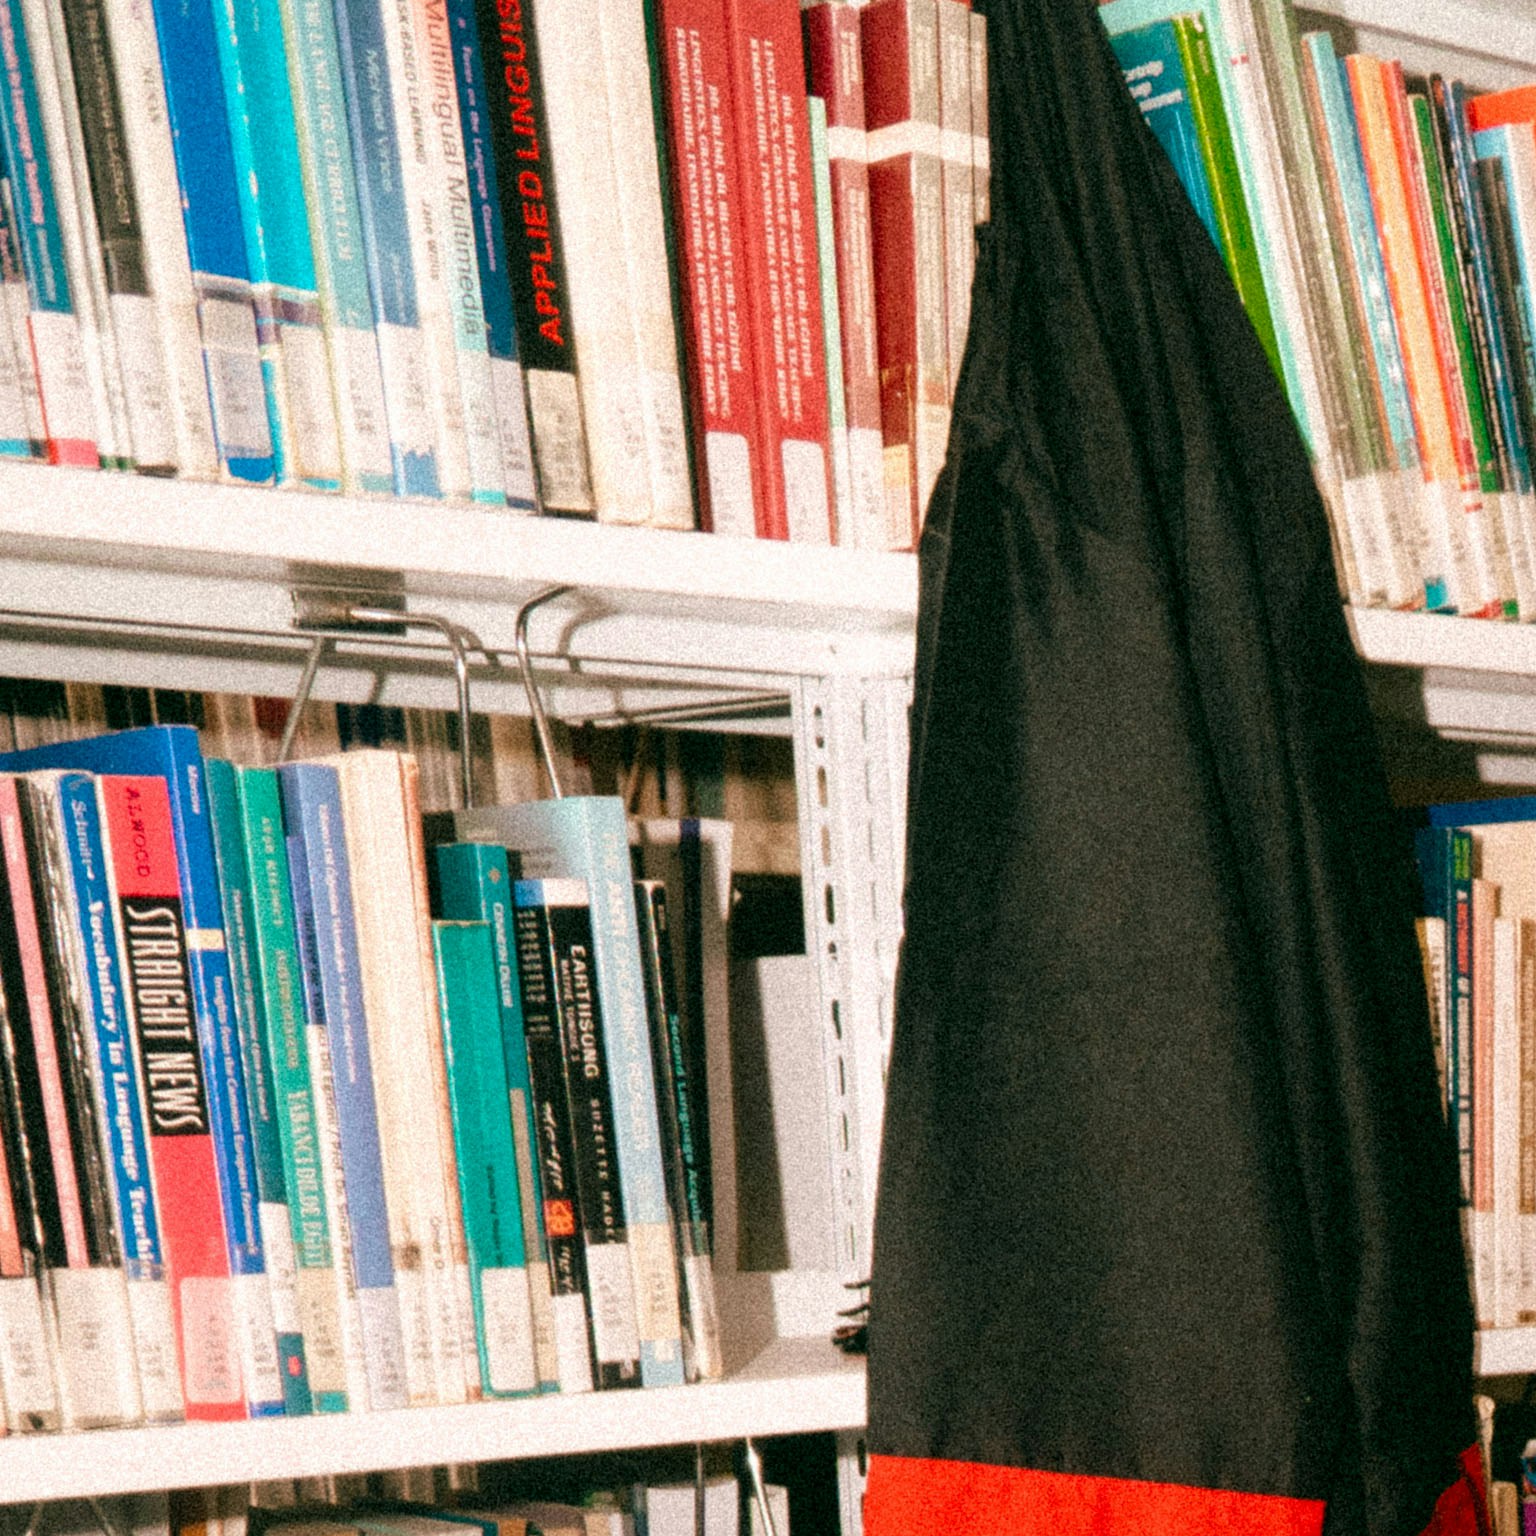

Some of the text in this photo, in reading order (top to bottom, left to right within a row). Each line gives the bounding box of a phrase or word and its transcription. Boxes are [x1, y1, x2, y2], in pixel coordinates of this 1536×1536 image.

[396, 1, 416, 82] SK-BASED
[418, 0, 486, 336] Multilingual Multimedia
[520, 168, 562, 348] APPLIED
[125, 786, 150, 878] ALWOOD
[83, 900, 120, 1034] Vocabulary
[107, 1071, 140, 1181] Language
[125, 899, 204, 1136] STRAIGHT NEWS
[219, 1028, 234, 1054] from
[571, 944, 598, 1078] EARTHSONG
[669, 1014, 685, 1076] Second
[225, 1079, 243, 1131] Common
[285, 1090, 316, 1164] YABANCI
[675, 1081, 695, 1163] Language
[230, 1134, 249, 1189] European
